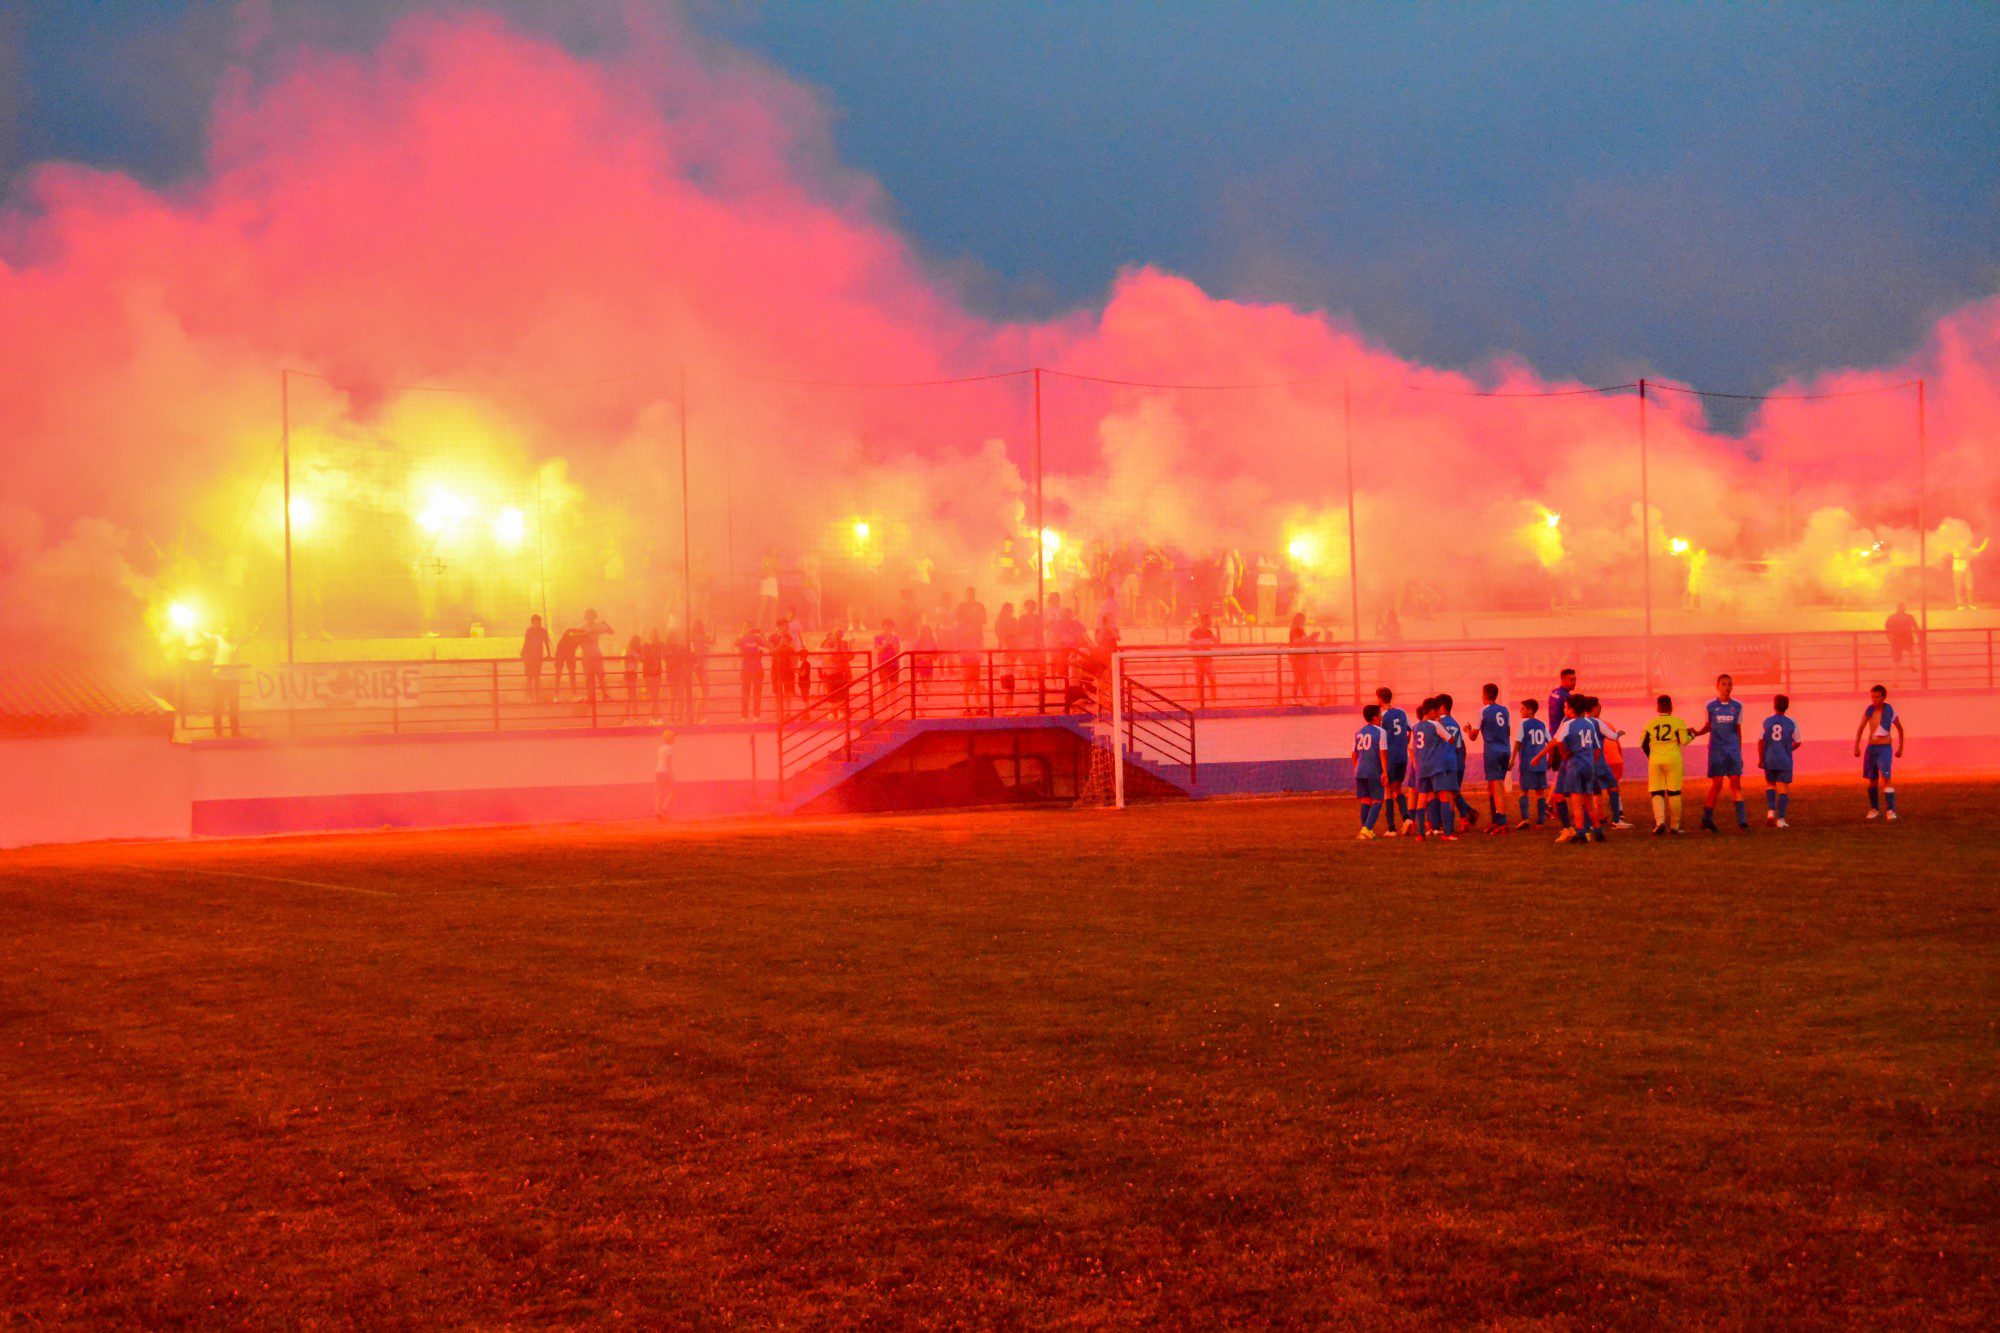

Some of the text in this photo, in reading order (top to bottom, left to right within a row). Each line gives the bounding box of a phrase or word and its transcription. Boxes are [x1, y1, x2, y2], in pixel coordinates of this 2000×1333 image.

[1392, 718, 1402, 736] 5
[1495, 711, 1505, 728] 6
[1356, 733, 1372, 751] 20
[1416, 731, 1426, 749] 3
[1528, 728, 1545, 746] 10
[1578, 729, 1593, 748] 14
[1653, 724, 1672, 742] 12
[1771, 724, 1782, 742] 8
